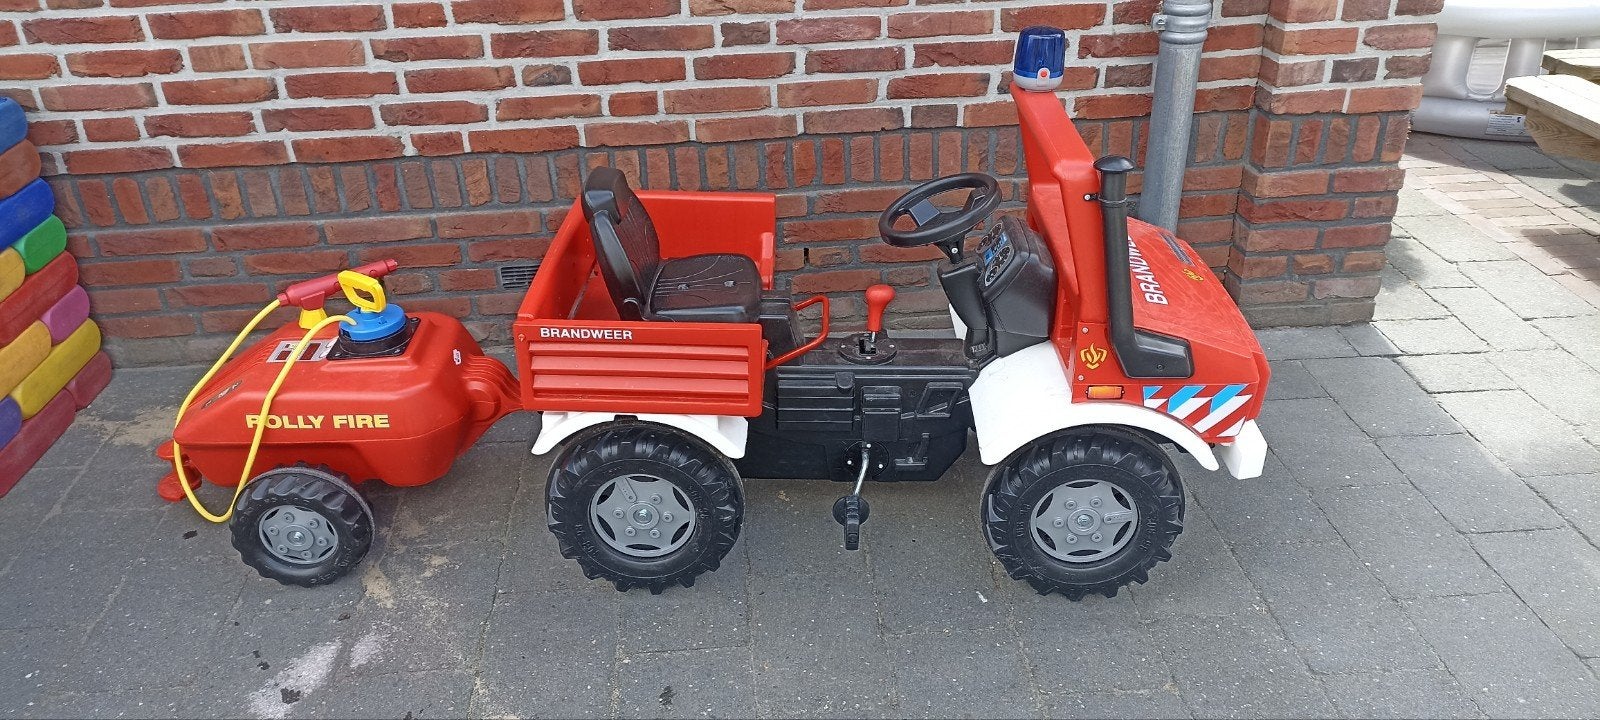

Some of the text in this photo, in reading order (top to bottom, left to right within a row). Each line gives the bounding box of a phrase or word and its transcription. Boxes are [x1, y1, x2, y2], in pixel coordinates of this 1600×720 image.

[540, 327, 633, 340] BRANDWEER
[245, 414, 390, 429] ROLLY FIRE
